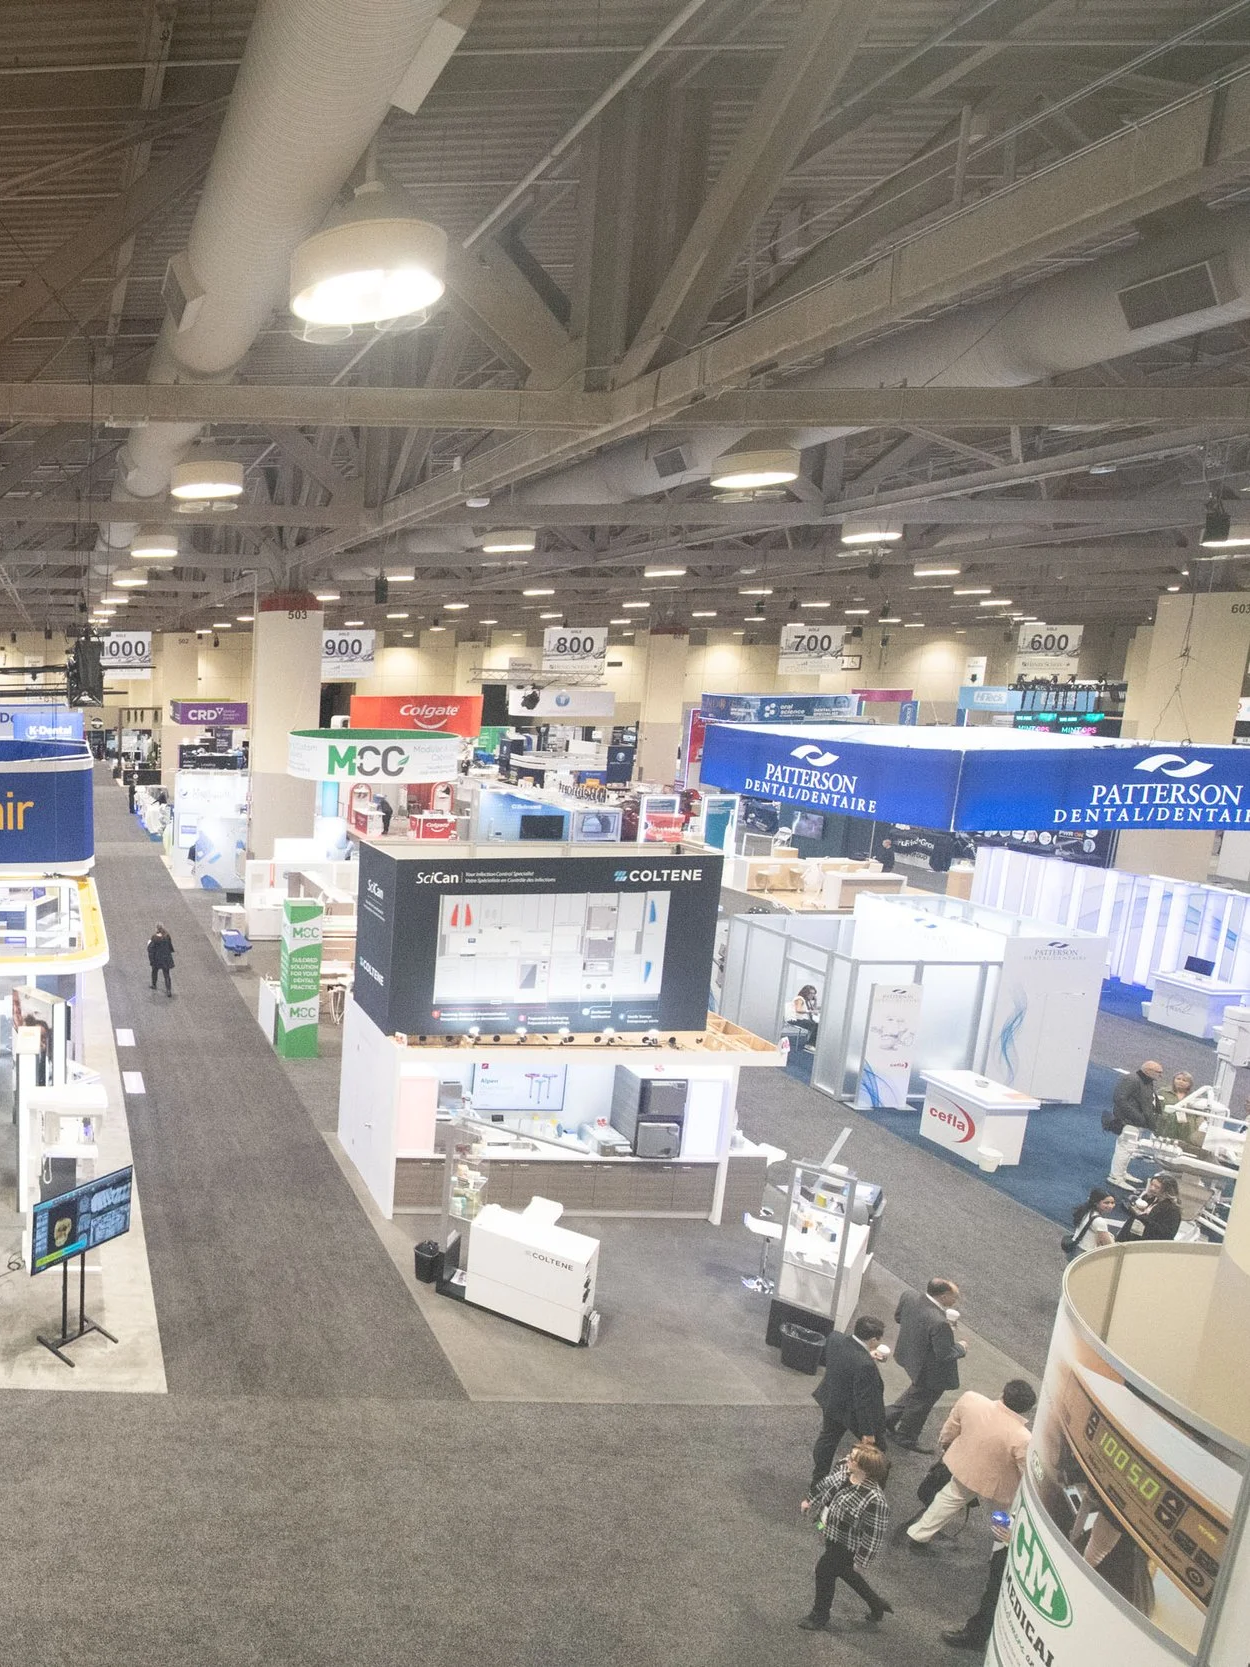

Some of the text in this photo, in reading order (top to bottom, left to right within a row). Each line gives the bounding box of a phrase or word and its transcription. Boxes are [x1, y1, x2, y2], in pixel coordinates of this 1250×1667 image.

[288, 610, 308, 620] 503
[102, 641, 146, 657] 000
[325, 639, 362, 655] 900
[556, 636, 594, 653] 800
[794, 635, 831, 651] 700
[1031, 634, 1068, 651] 600
[188, 709, 218, 720] CRD
[400, 704, 459, 718] Colgate
[328, 745, 405, 776] MCC
[765, 763, 858, 794] PATTERSON
[745, 779, 877, 813] DENTAL/DENTAIRE
[1090, 784, 1243, 806] PATTERSON
[416, 872, 459, 884] SciCan
[629, 869, 703, 882] COLTENE
[367, 879, 384, 900] SciCan
[293, 927, 319, 938] MCC
[290, 1008, 316, 1018] MCC
[929, 1106, 966, 1132] cefla
[532, 1251, 575, 1271] COLTENE
